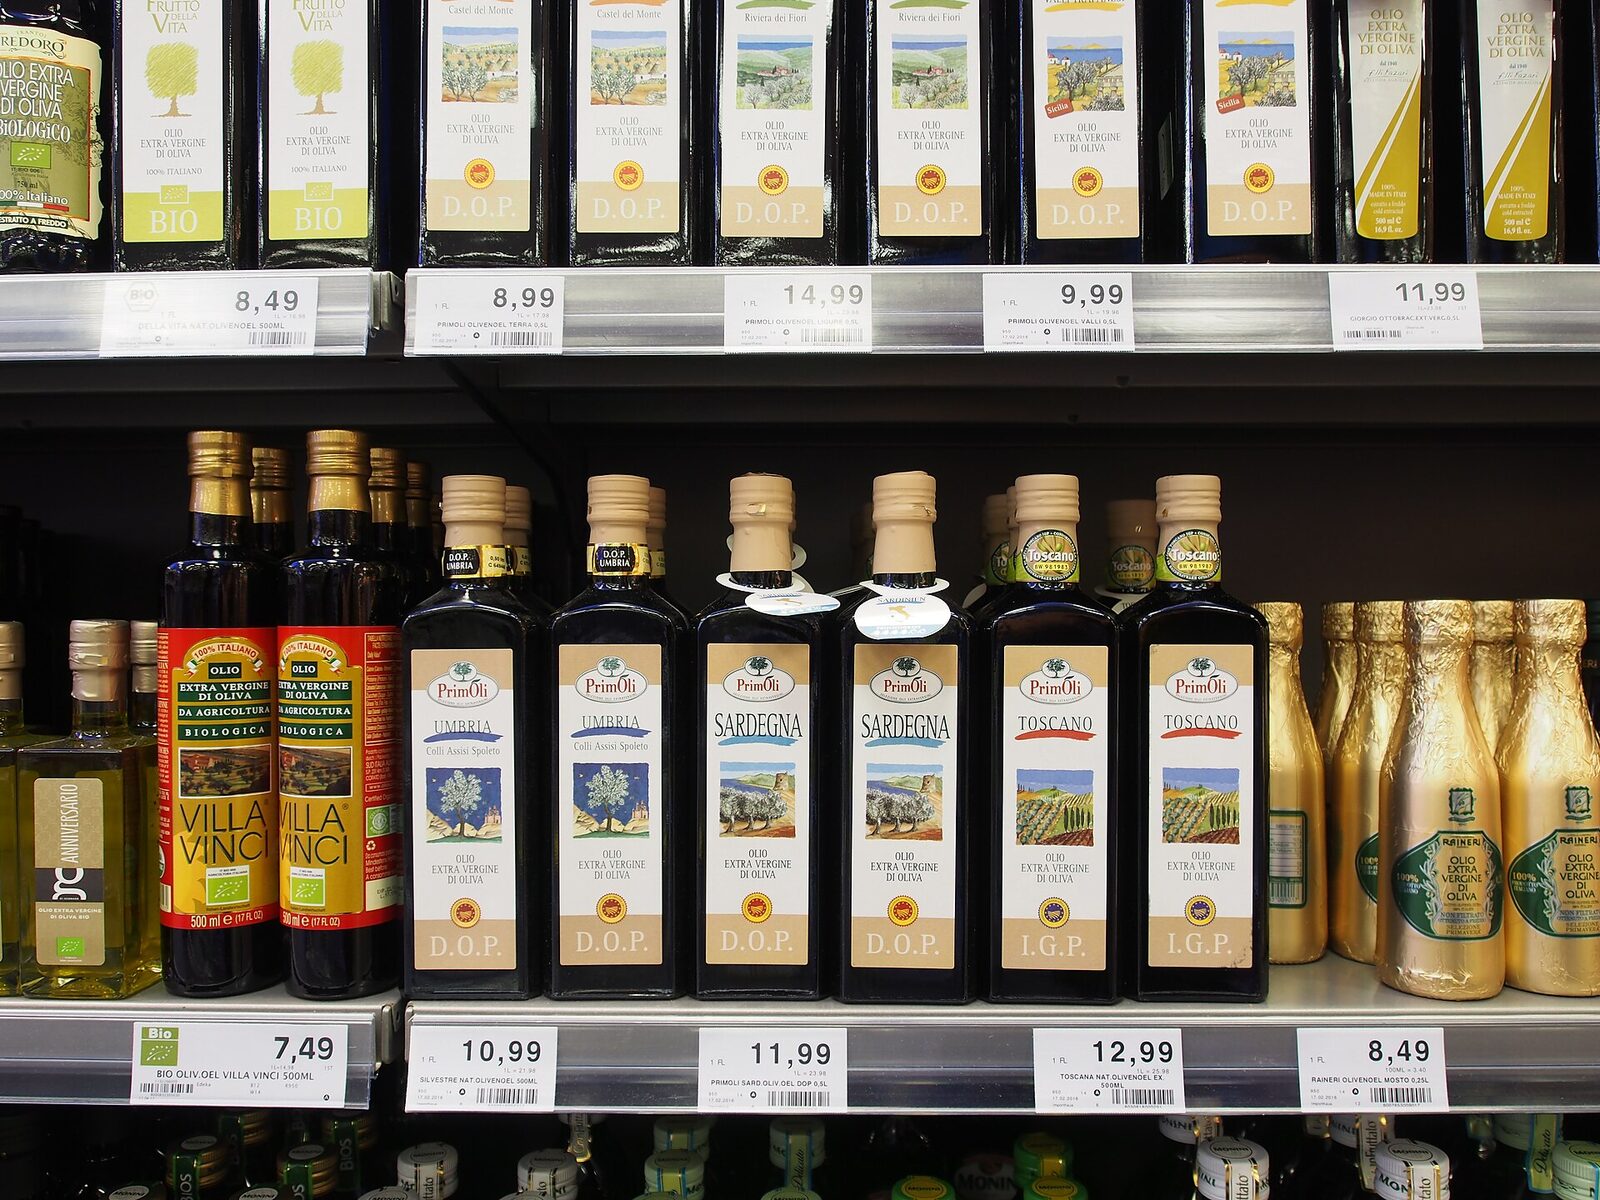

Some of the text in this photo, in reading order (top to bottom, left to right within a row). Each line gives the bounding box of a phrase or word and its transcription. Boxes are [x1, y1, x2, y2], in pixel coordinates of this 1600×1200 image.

[171, 13, 198, 21] DELLA
[448, 6, 514, 15] Castel del Monte
[898, 12, 960, 22] Riviera dei Fiori
[1370, 9, 1404, 20] OLIO
[149, 11, 188, 34] VITA
[1368, 22, 1407, 32] EXTRA
[1358, 33, 1415, 44] VERGINE
[1360, 44, 1415, 55] DI OLIVA
[29, 63, 75, 87] EXTRA
[0, 79, 63, 102] VERGINE
[1, 97, 63, 120] DI OLIVA
[1046, 102, 1068, 115] Sicilia
[1218, 98, 1240, 110] Sicilia
[471, 114, 490, 122] OLIO
[922, 120, 940, 130] OLIO
[164, 128, 182, 138] OLIO
[447, 124, 514, 134] EXTRA VERGINE
[1078, 122, 1096, 132] OLIO
[462, 135, 498, 144] DI OLIVA
[898, 131, 965, 140] EXTRA VERGINE
[1054, 133, 1120, 142] EXTRA VERGINE
[140, 138, 206, 148] EXTRA VERGINE
[914, 141, 949, 150] DI OLIVA
[1070, 143, 1106, 152] DI OLIVA
[156, 149, 192, 158] DI OLIVA
[166, 168, 202, 176] ITALIANO
[27, 190, 69, 205] Italiano
[443, 196, 516, 218] D.O.P.
[592, 198, 665, 220] D.O.P.
[736, 203, 809, 224] D.O.P.
[895, 202, 968, 224] D.O.P.
[1224, 201, 1296, 222] D.O.P.
[150, 209, 198, 234] BIO
[294, 206, 343, 232] BIO
[1052, 204, 1124, 226] D.O.P.
[38, 218, 67, 228] FREDDO
[493, 288, 555, 311] 8,99
[784, 285, 863, 309] 14,99
[1061, 284, 1123, 308] 9,99
[1396, 282, 1465, 304] 11,99
[235, 290, 299, 315] 8,49
[604, 550, 626, 558] D.O.P.
[1028, 549, 1074, 562] Toscano
[1172, 550, 1220, 562] Toscano
[600, 558, 630, 567] UMBRIA
[194, 644, 257, 660] 100% ITALIANO
[180, 682, 268, 692] EXTRA VERGINE
[438, 680, 488, 698] PrimOli
[586, 676, 636, 694] PrimOli
[737, 676, 779, 692] PrimOli
[884, 677, 927, 693] PrimOli
[1030, 676, 1081, 695] PrimOli
[1176, 674, 1226, 694] PrimOli
[179, 706, 270, 717] DA AGRICOLTURA
[284, 707, 350, 716] AGRICOLTURA
[434, 720, 492, 734] UMBRIA
[582, 716, 640, 729] UMBRIA
[714, 712, 802, 738] SARDEGNA
[862, 714, 950, 739] SARDEGNA
[1018, 716, 1092, 730] TOSCANO
[1164, 714, 1238, 730] TOSCANO
[186, 727, 264, 736] BIOLOGICA
[574, 742, 648, 752] Colli Assisi Spoleto
[180, 800, 266, 832] VILLA
[60, 784, 79, 864] ANNIVERSARIO
[180, 830, 268, 864] VINCI
[748, 849, 768, 858] OLIO
[724, 860, 792, 868] EXTRA VERGINE
[1450, 856, 1475, 865] OLIO
[740, 870, 776, 878] DI OLIVA
[1448, 865, 1477, 874] EXTRA
[1442, 874, 1482, 883] VERGINE
[1458, 884, 1468, 892] DI
[190, 916, 220, 928] 500 ml
[430, 936, 502, 956] D.O.P.
[576, 931, 648, 952] D.O.P.
[720, 931, 793, 951] D.O.P.
[866, 934, 940, 955] D.O.P.
[1021, 936, 1086, 957] I.G.P.
[1168, 933, 1232, 954] I.G.P.
[150, 1028, 171, 1039] Bio
[274, 1036, 333, 1063] 7,49
[463, 1040, 541, 1066] 10,99
[752, 1043, 830, 1069] 11,99
[1093, 1040, 1173, 1067] 12,99
[1368, 1040, 1430, 1066] 8,49
[156, 1070, 173, 1078] BIO
[177, 1070, 219, 1078] OLIV.OEL
[223, 1071, 250, 1079] VILLA
[283, 1072, 313, 1080] 500ML
